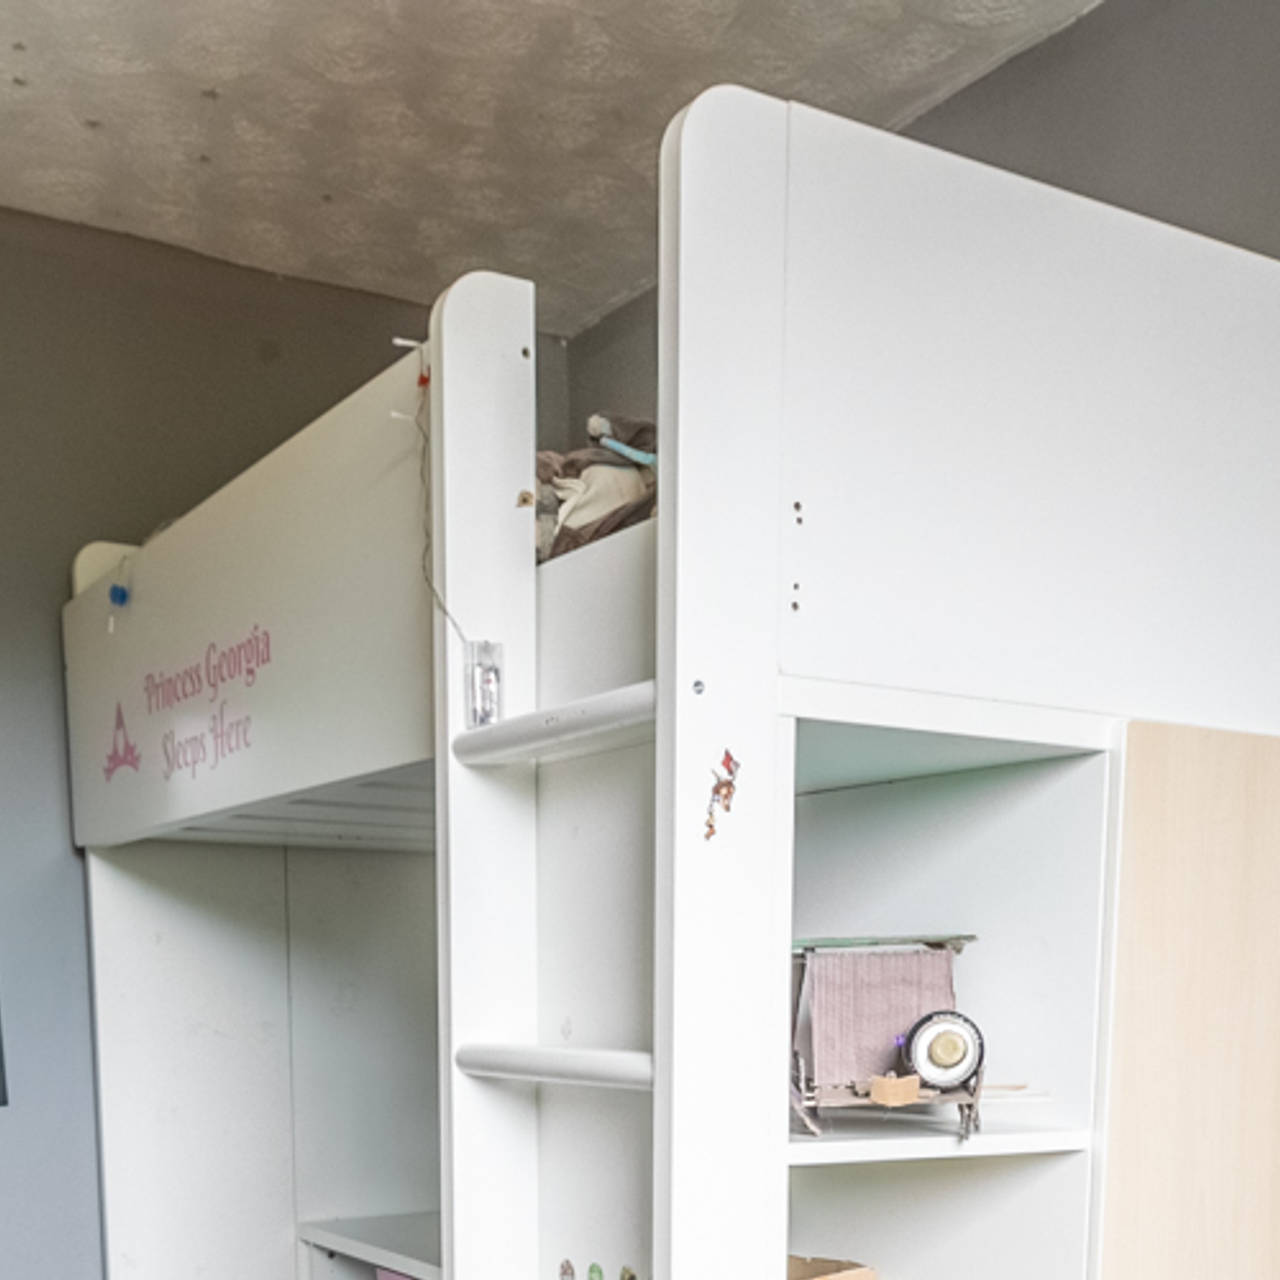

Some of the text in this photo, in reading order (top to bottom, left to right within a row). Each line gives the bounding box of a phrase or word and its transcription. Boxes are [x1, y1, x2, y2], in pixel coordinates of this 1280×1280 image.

[144, 623, 271, 715] Princess Georgia
[162, 700, 252, 781] Sleeps Here
